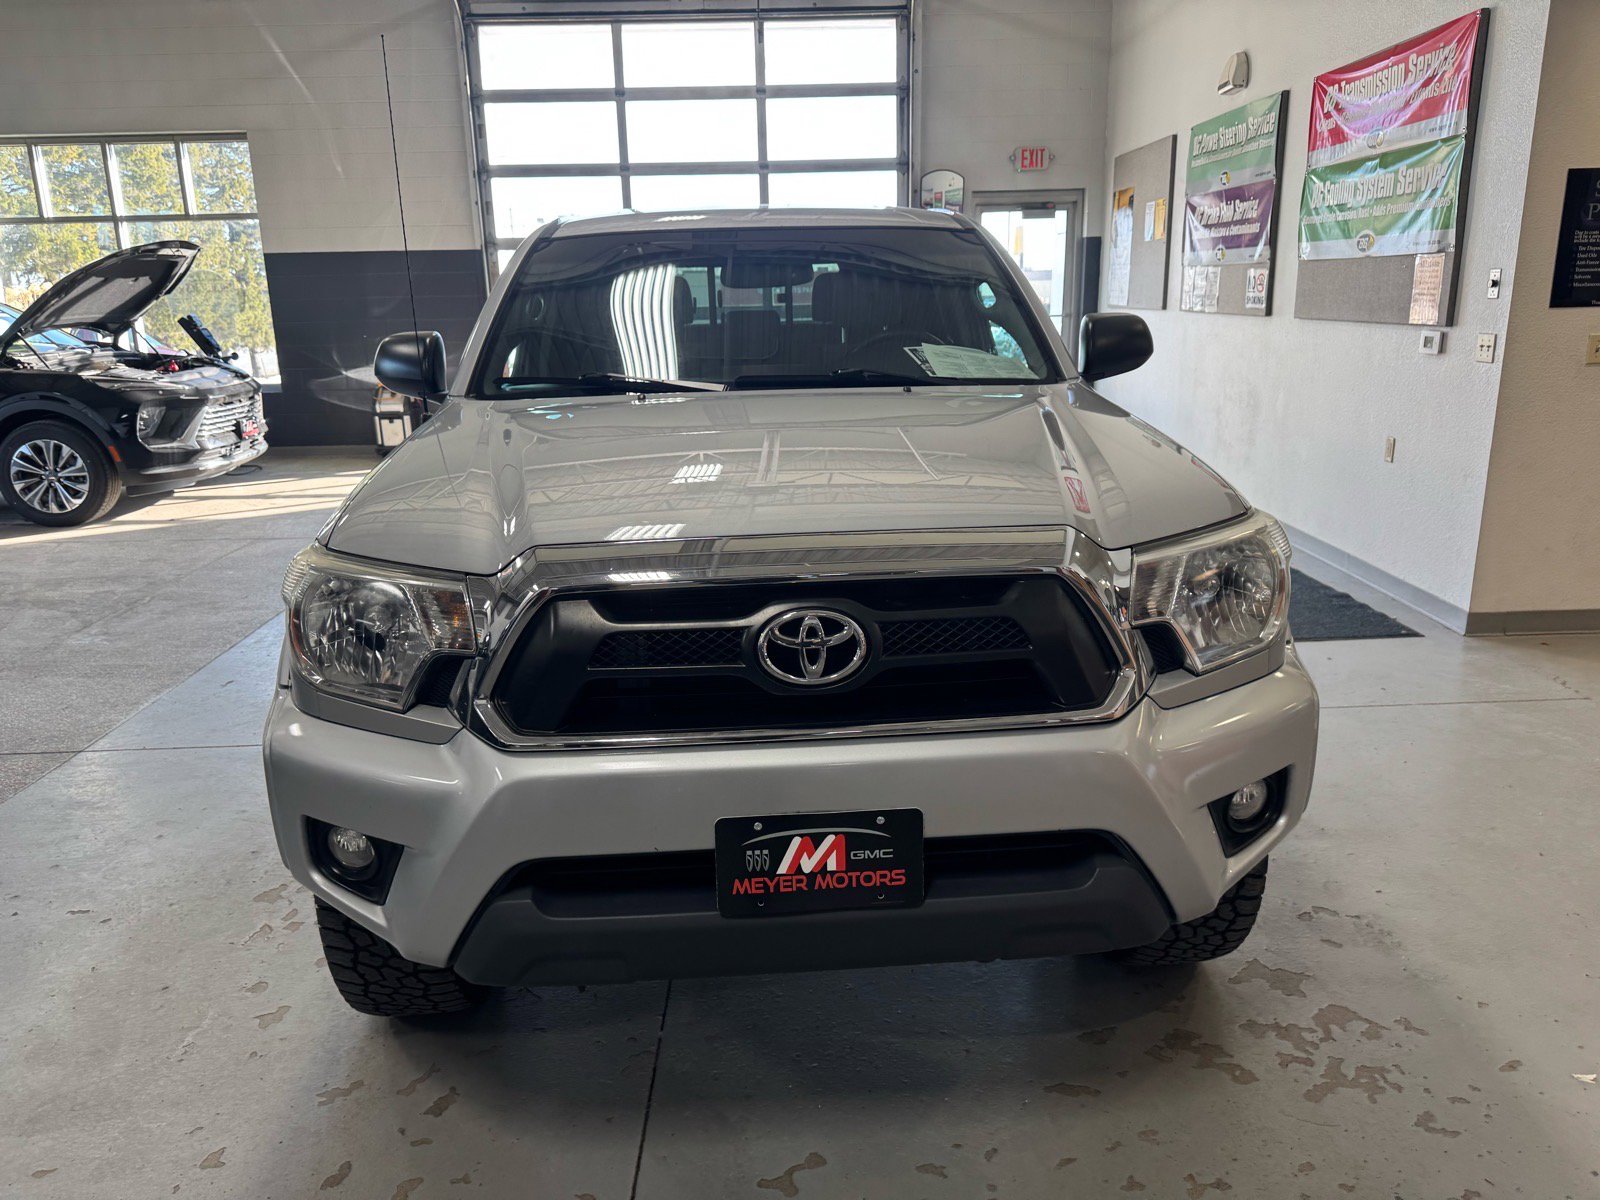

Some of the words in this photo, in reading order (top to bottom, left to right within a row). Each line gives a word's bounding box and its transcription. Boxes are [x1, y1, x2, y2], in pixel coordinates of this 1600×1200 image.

[1407, 41, 1458, 82] Service
[1219, 122, 1247, 149] Steering
[1247, 111, 1275, 139] Service
[1021, 148, 1046, 169] EXIT
[1325, 178, 1355, 208] Cooling
[1356, 171, 1395, 205] System
[1396, 163, 1447, 195] Service
[1234, 196, 1259, 220] Service
[850, 849, 894, 860] GMC
[732, 874, 808, 895] MEYER
[814, 869, 906, 890] MOTORS
